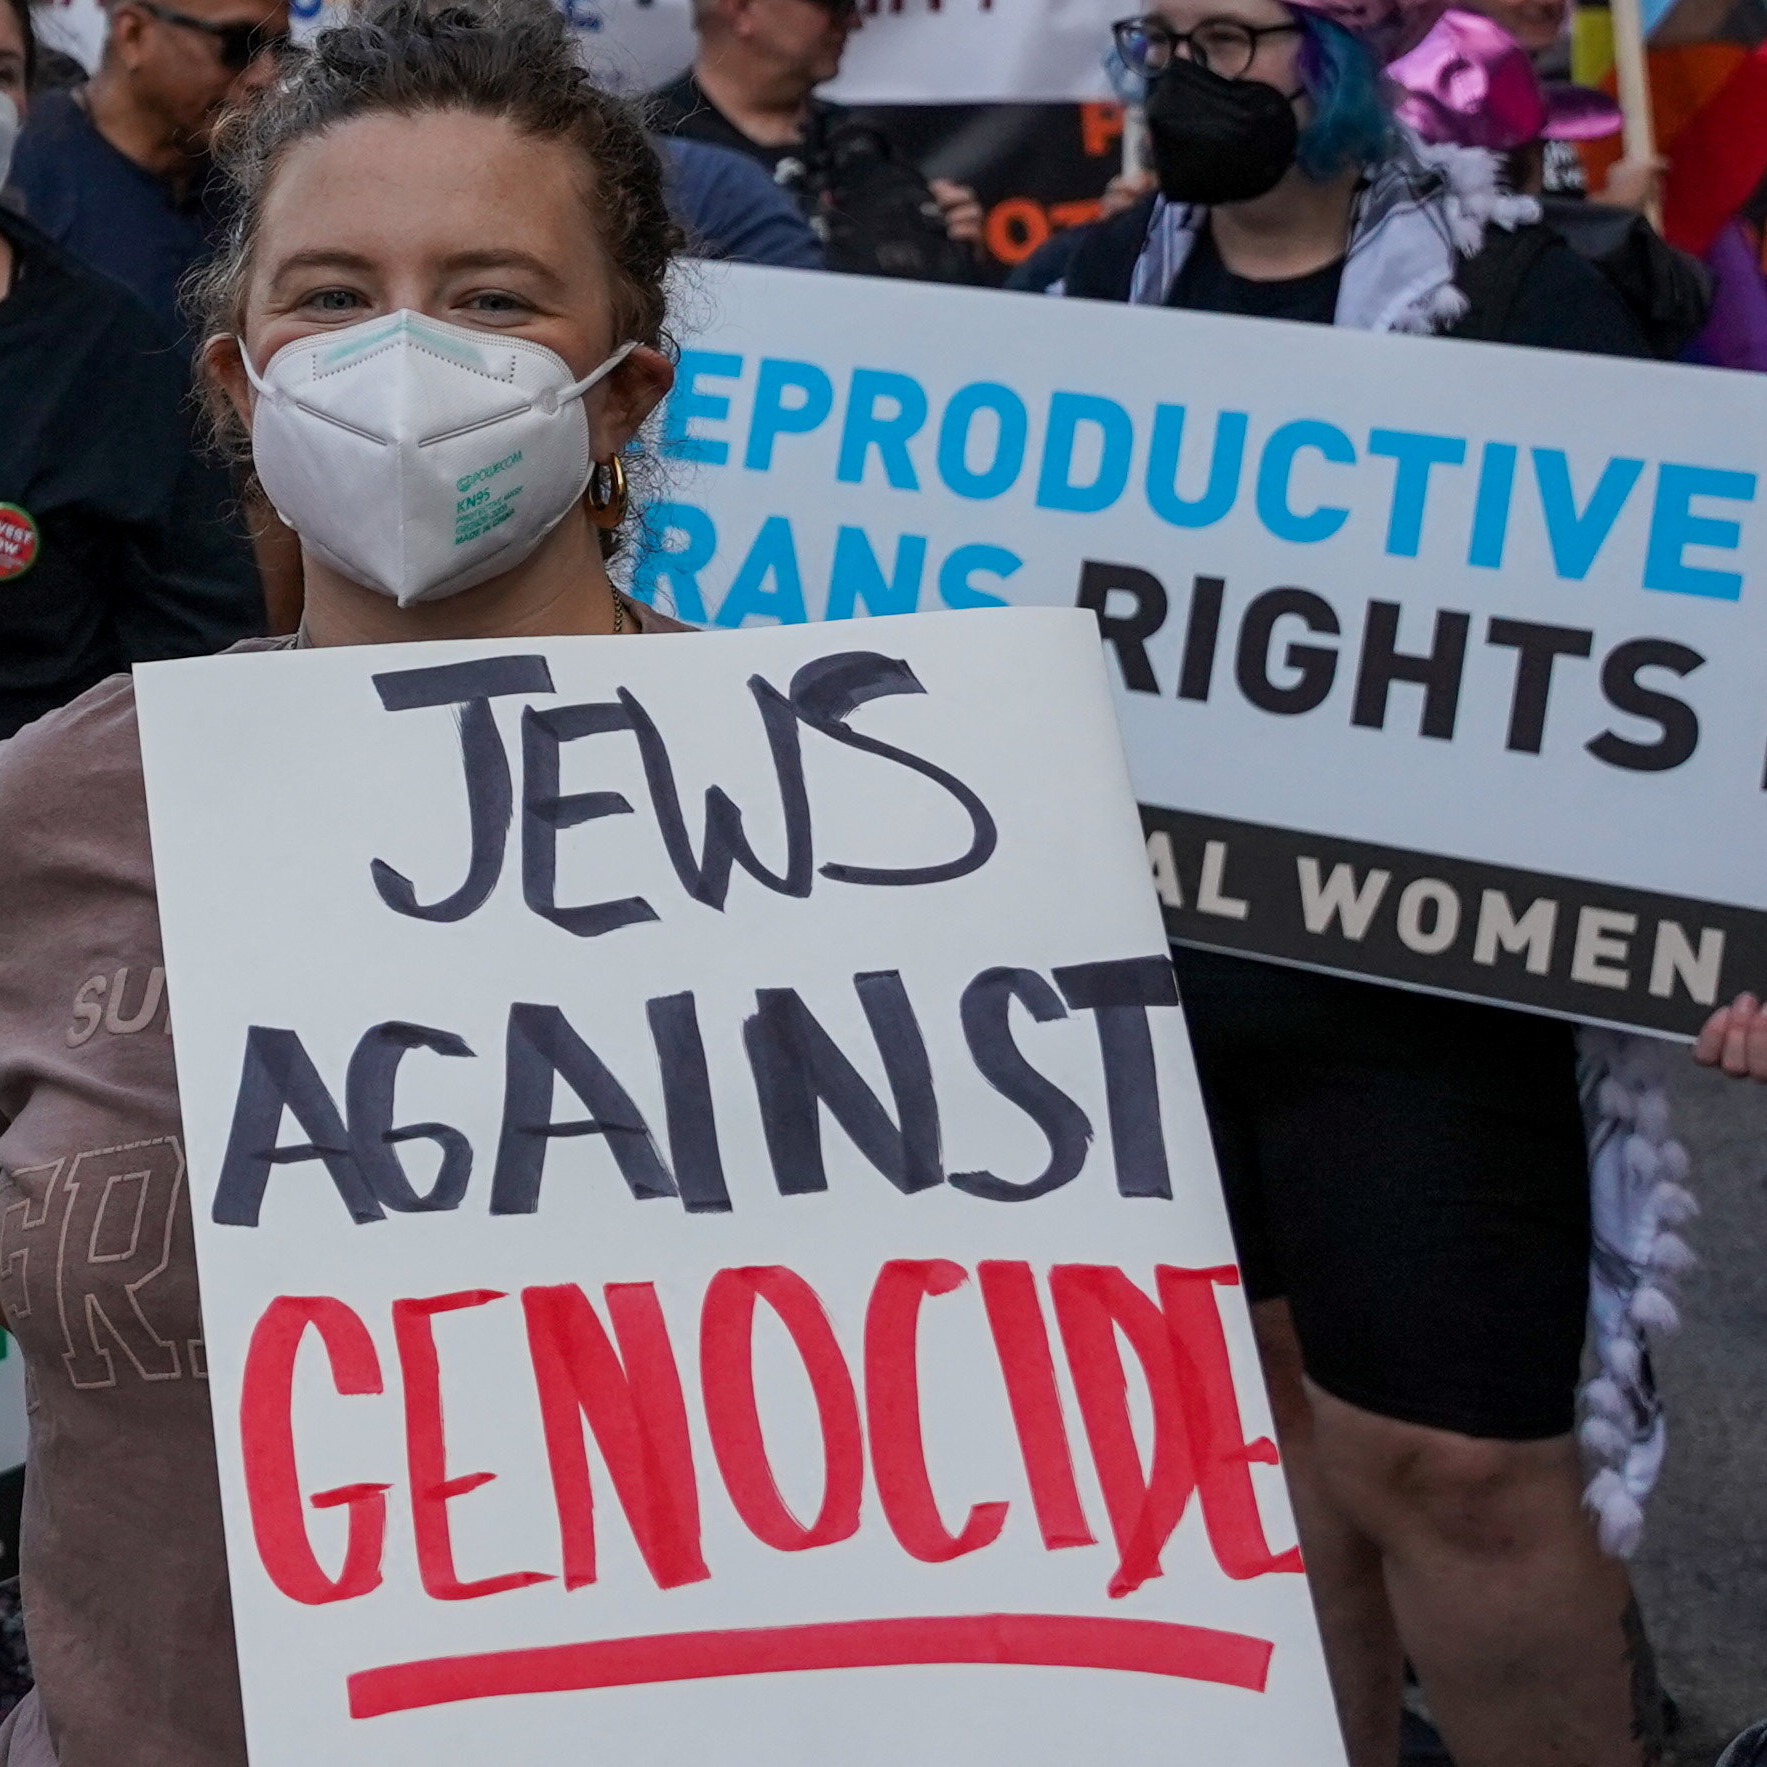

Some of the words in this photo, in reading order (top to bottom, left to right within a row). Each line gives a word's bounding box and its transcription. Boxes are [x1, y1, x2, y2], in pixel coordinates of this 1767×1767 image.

[456, 486, 491, 513] KN95
[657, 349, 1757, 603] EPRODUCTIVE
[1076, 557, 1707, 773] RIGHTS
[370, 650, 998, 938] JEWS
[64, 967, 170, 1050] SU
[1296, 855, 1726, 1006] WOMEN
[212, 953, 1181, 1228] AGAINST
[239, 1258, 1306, 1605] GENOCIDE
